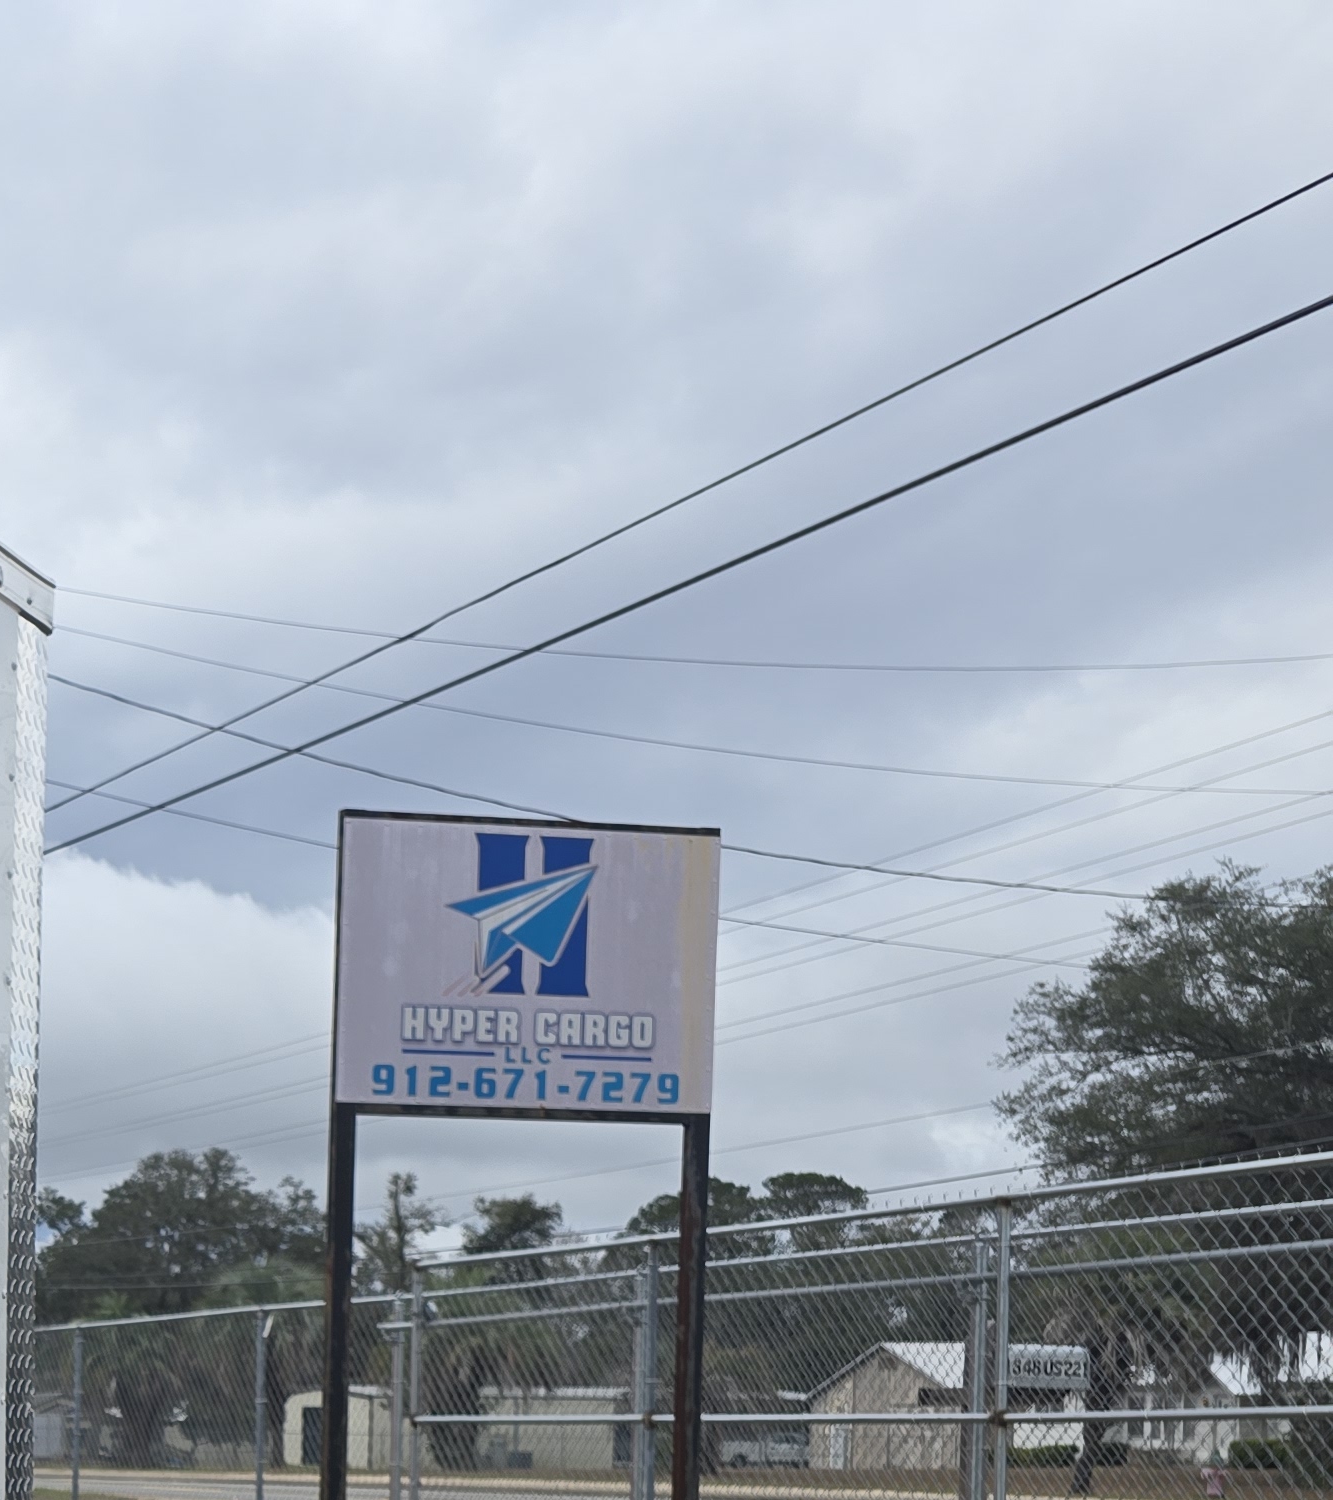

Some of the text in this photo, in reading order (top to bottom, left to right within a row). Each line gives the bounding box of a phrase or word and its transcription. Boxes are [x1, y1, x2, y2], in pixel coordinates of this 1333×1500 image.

[402, 1006, 654, 1048] HYPER CARGO
[504, 1046, 552, 1064] LLC
[372, 1064, 679, 1105] 912-671-7279
